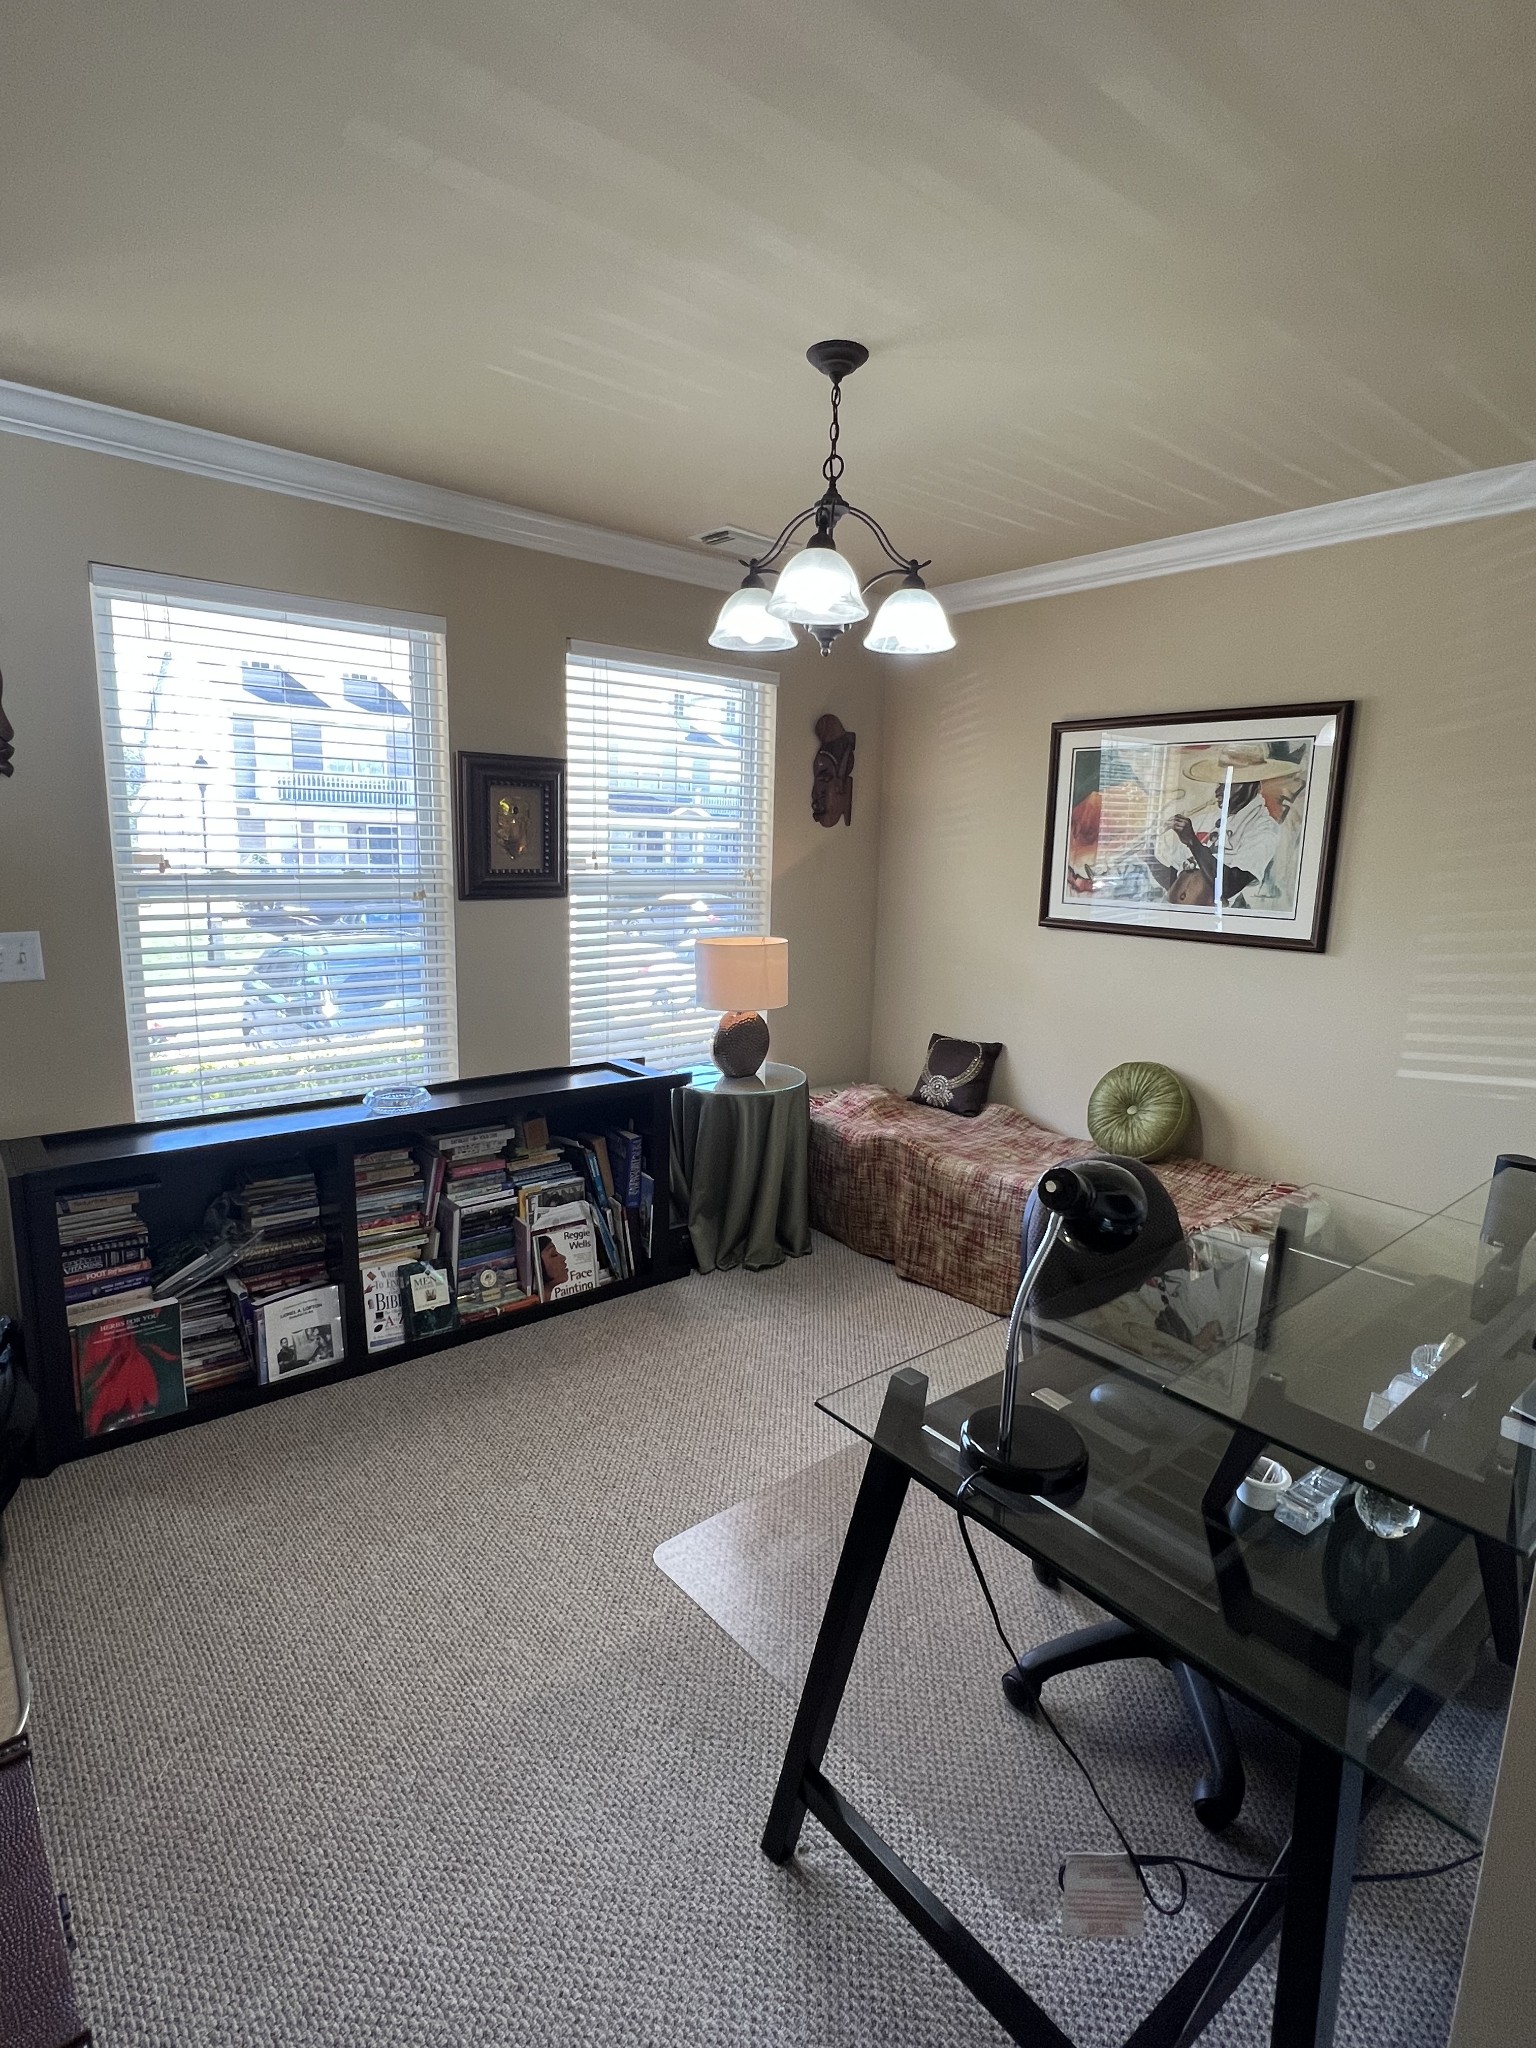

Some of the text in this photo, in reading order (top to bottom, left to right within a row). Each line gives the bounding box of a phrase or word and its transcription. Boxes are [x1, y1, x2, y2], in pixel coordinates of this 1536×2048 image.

[564, 1229, 591, 1241] Reggie
[569, 1240, 591, 1250] Wells
[87, 1270, 106, 1281] FOOT
[570, 1269, 593, 1281] Face
[554, 1281, 594, 1298] Painting
[99, 1320, 125, 1332] HERBS
[126, 1317, 141, 1326] FOR
[143, 1312, 159, 1321] YOU
